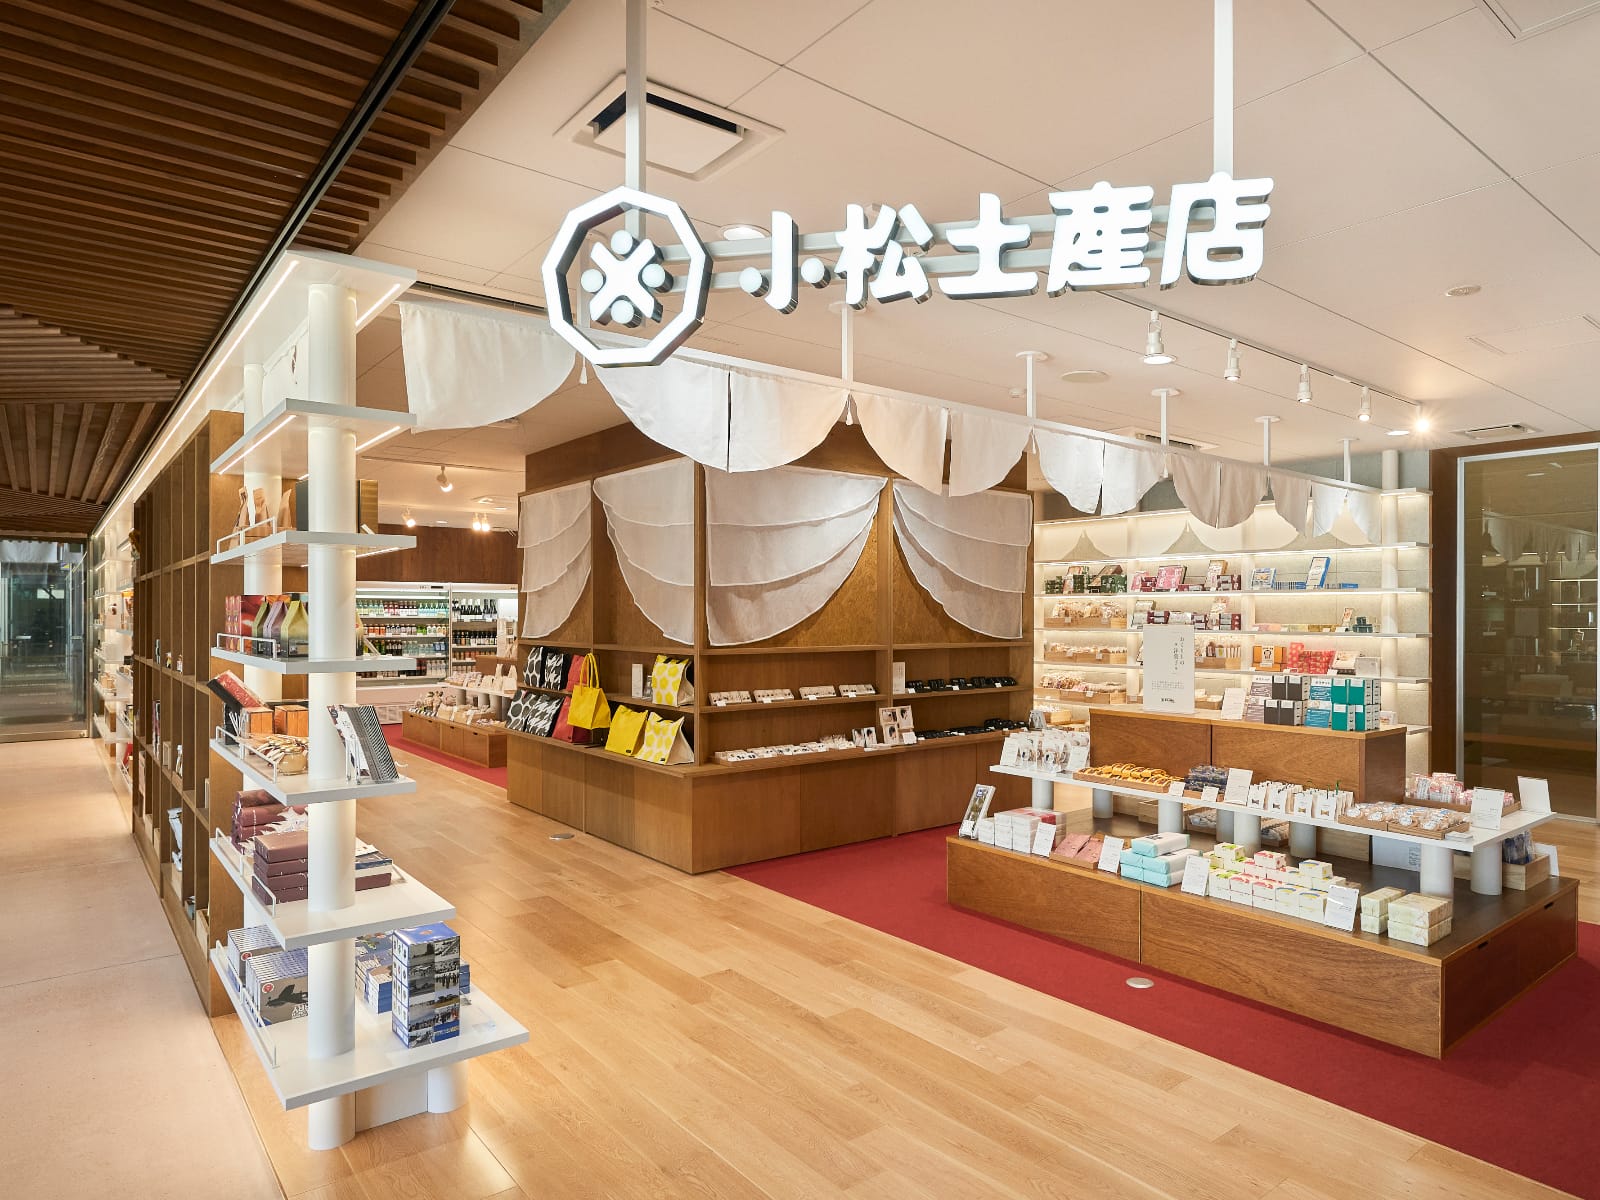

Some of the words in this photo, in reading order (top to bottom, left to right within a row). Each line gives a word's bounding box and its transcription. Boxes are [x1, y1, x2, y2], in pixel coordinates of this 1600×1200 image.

[739, 173, 1274, 314] 小松土産店
